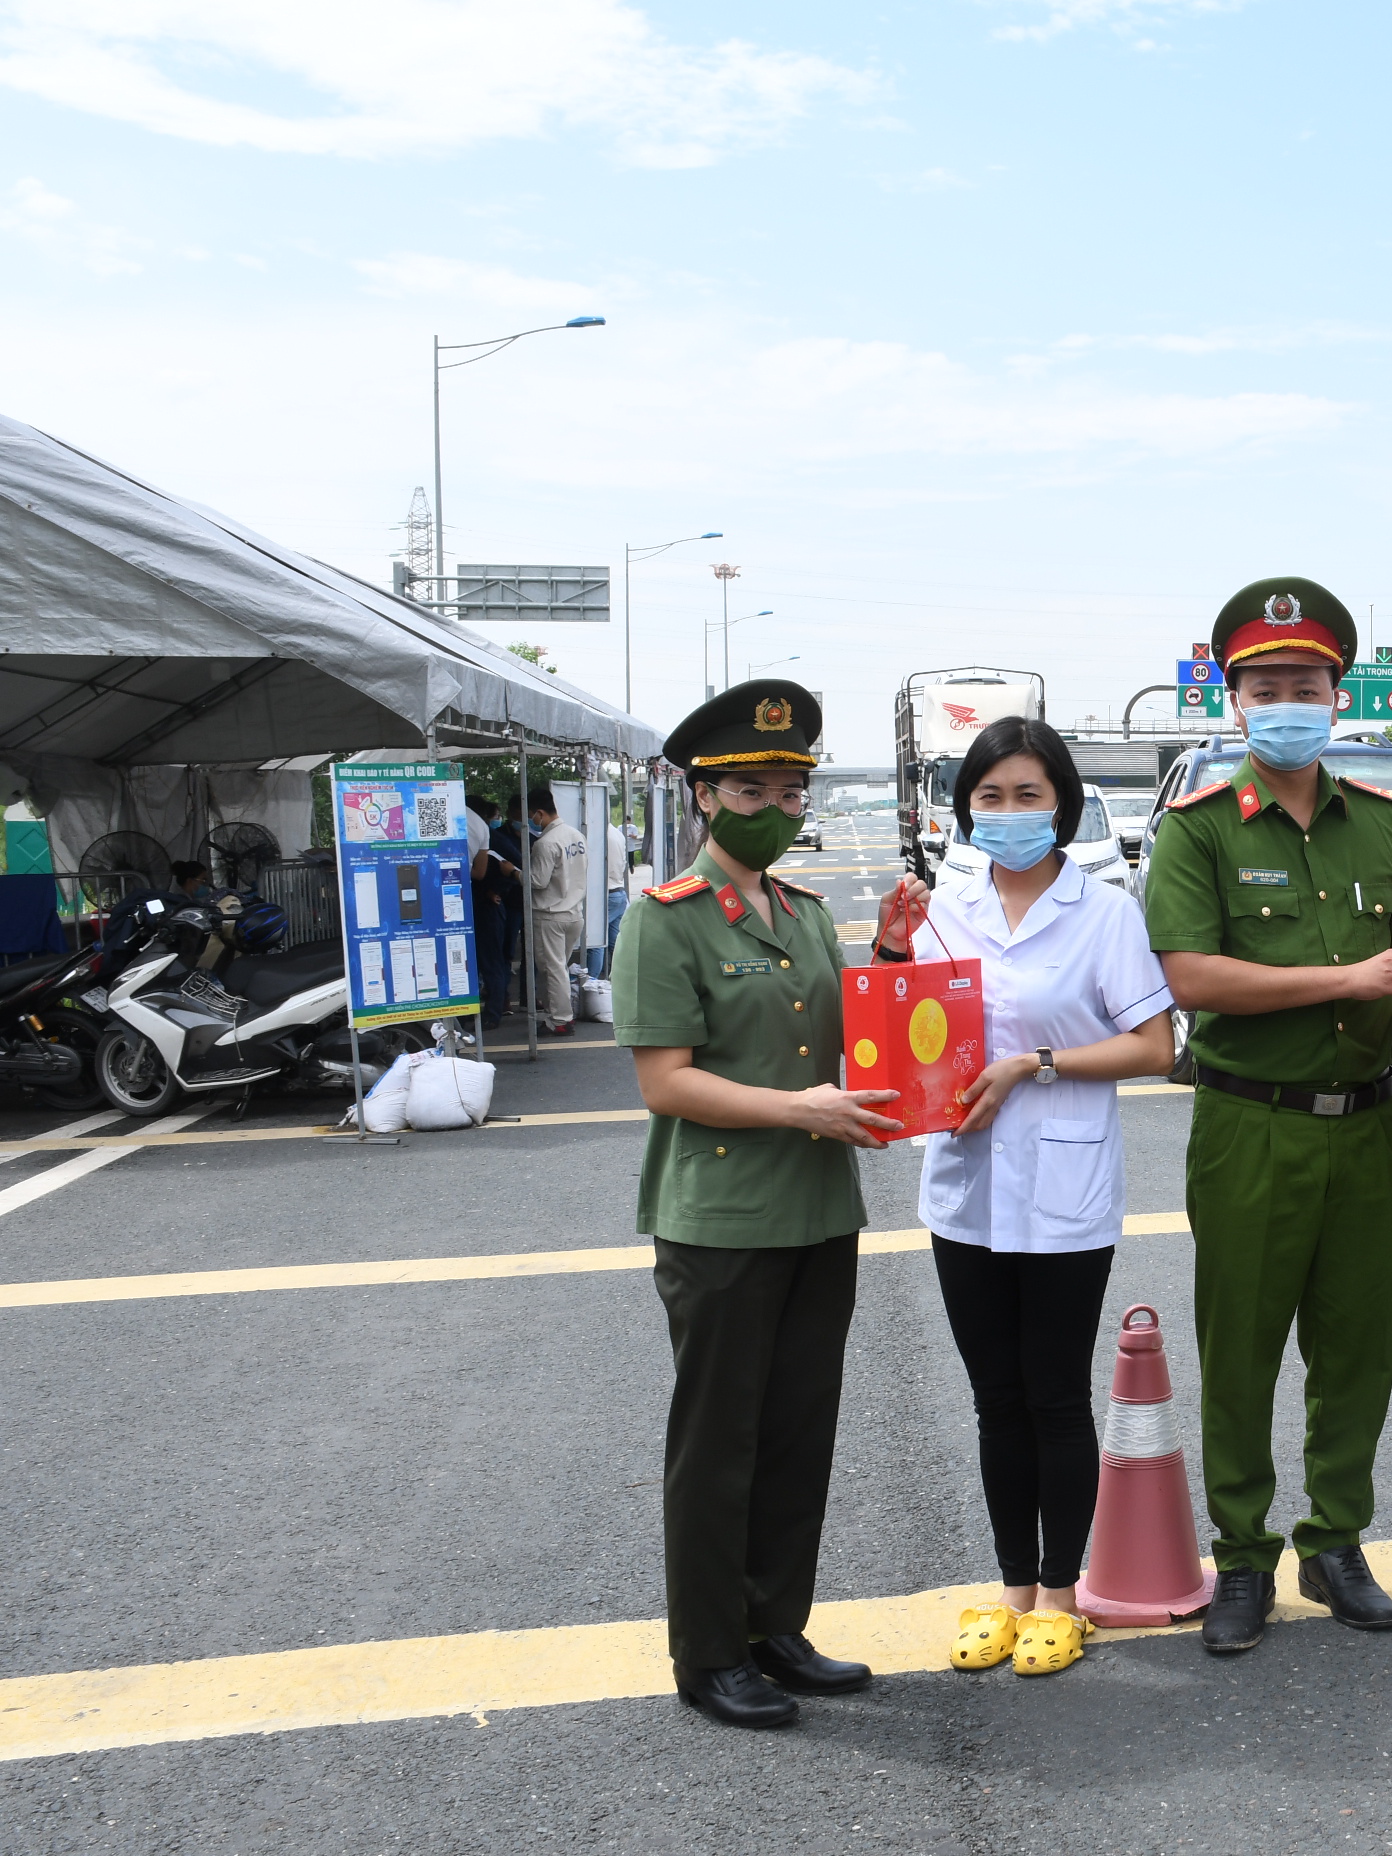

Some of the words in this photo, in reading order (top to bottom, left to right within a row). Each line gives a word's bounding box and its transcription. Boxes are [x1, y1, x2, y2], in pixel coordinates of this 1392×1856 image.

[1195, 668, 1206, 677] 80
[1353, 666, 1364, 676] TẢI
[1366, 668, 1392, 678] TRỌNG
[339, 766, 352, 777] ĐIỂM
[354, 768, 366, 777] KHAI
[378, 768, 383, 777] Y
[404, 766, 415, 778] QR
[416, 766, 436, 777] CODE
[564, 841, 586, 860] KCS
